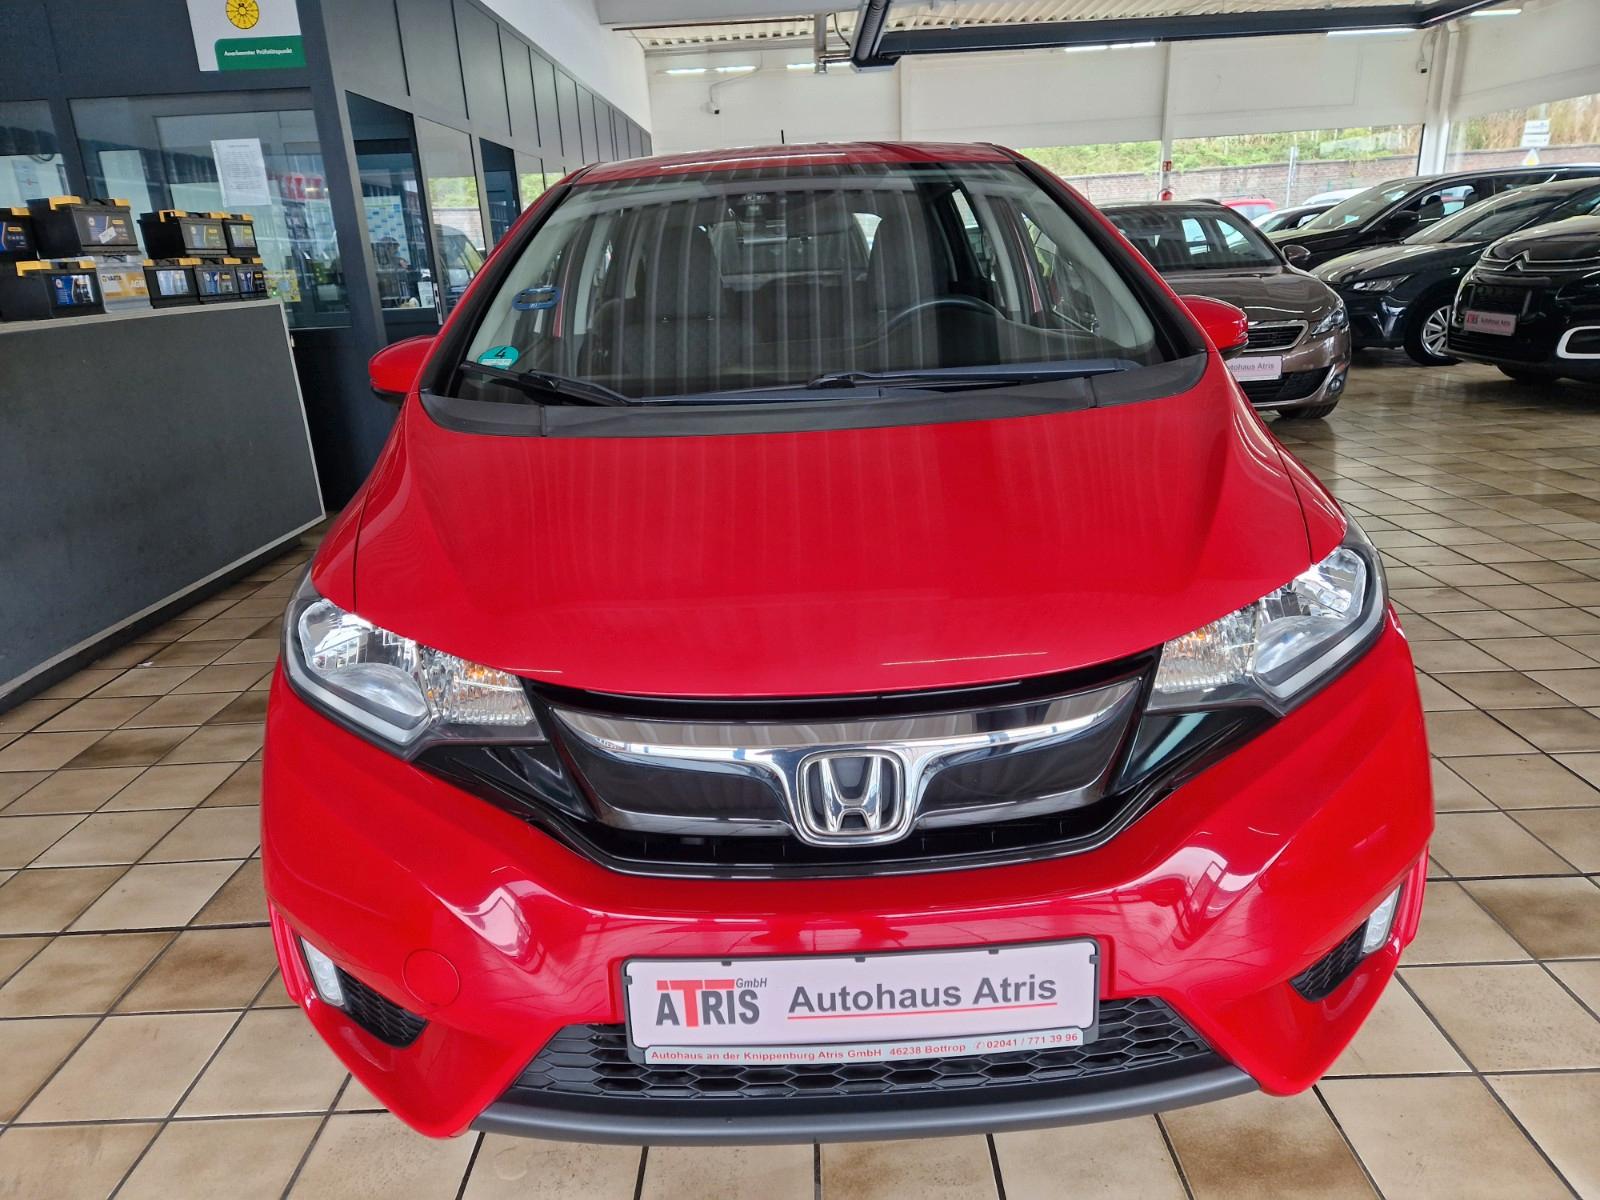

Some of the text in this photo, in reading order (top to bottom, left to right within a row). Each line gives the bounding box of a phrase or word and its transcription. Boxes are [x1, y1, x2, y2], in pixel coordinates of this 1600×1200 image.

[495, 346, 506, 358] 4
[735, 978, 767, 989] GmbH
[788, 974, 1057, 1013] Autohaus Atris
[656, 980, 760, 1027] ATRIS
[651, 1051, 703, 1060] Autohaus
[723, 1051, 740, 1060] der
[744, 1051, 815, 1061] Knippenburg
[818, 1049, 843, 1059] Atris
[847, 1048, 882, 1058] GmbH
[889, 1046, 922, 1056] 46238
[925, 1044, 966, 1054] Bottrop
[986, 1038, 1017, 1049] 02041
[1027, 1036, 1046, 1046] 771
[1050, 1034, 1063, 1043] 39
[1065, 1033, 1078, 1042] 96
